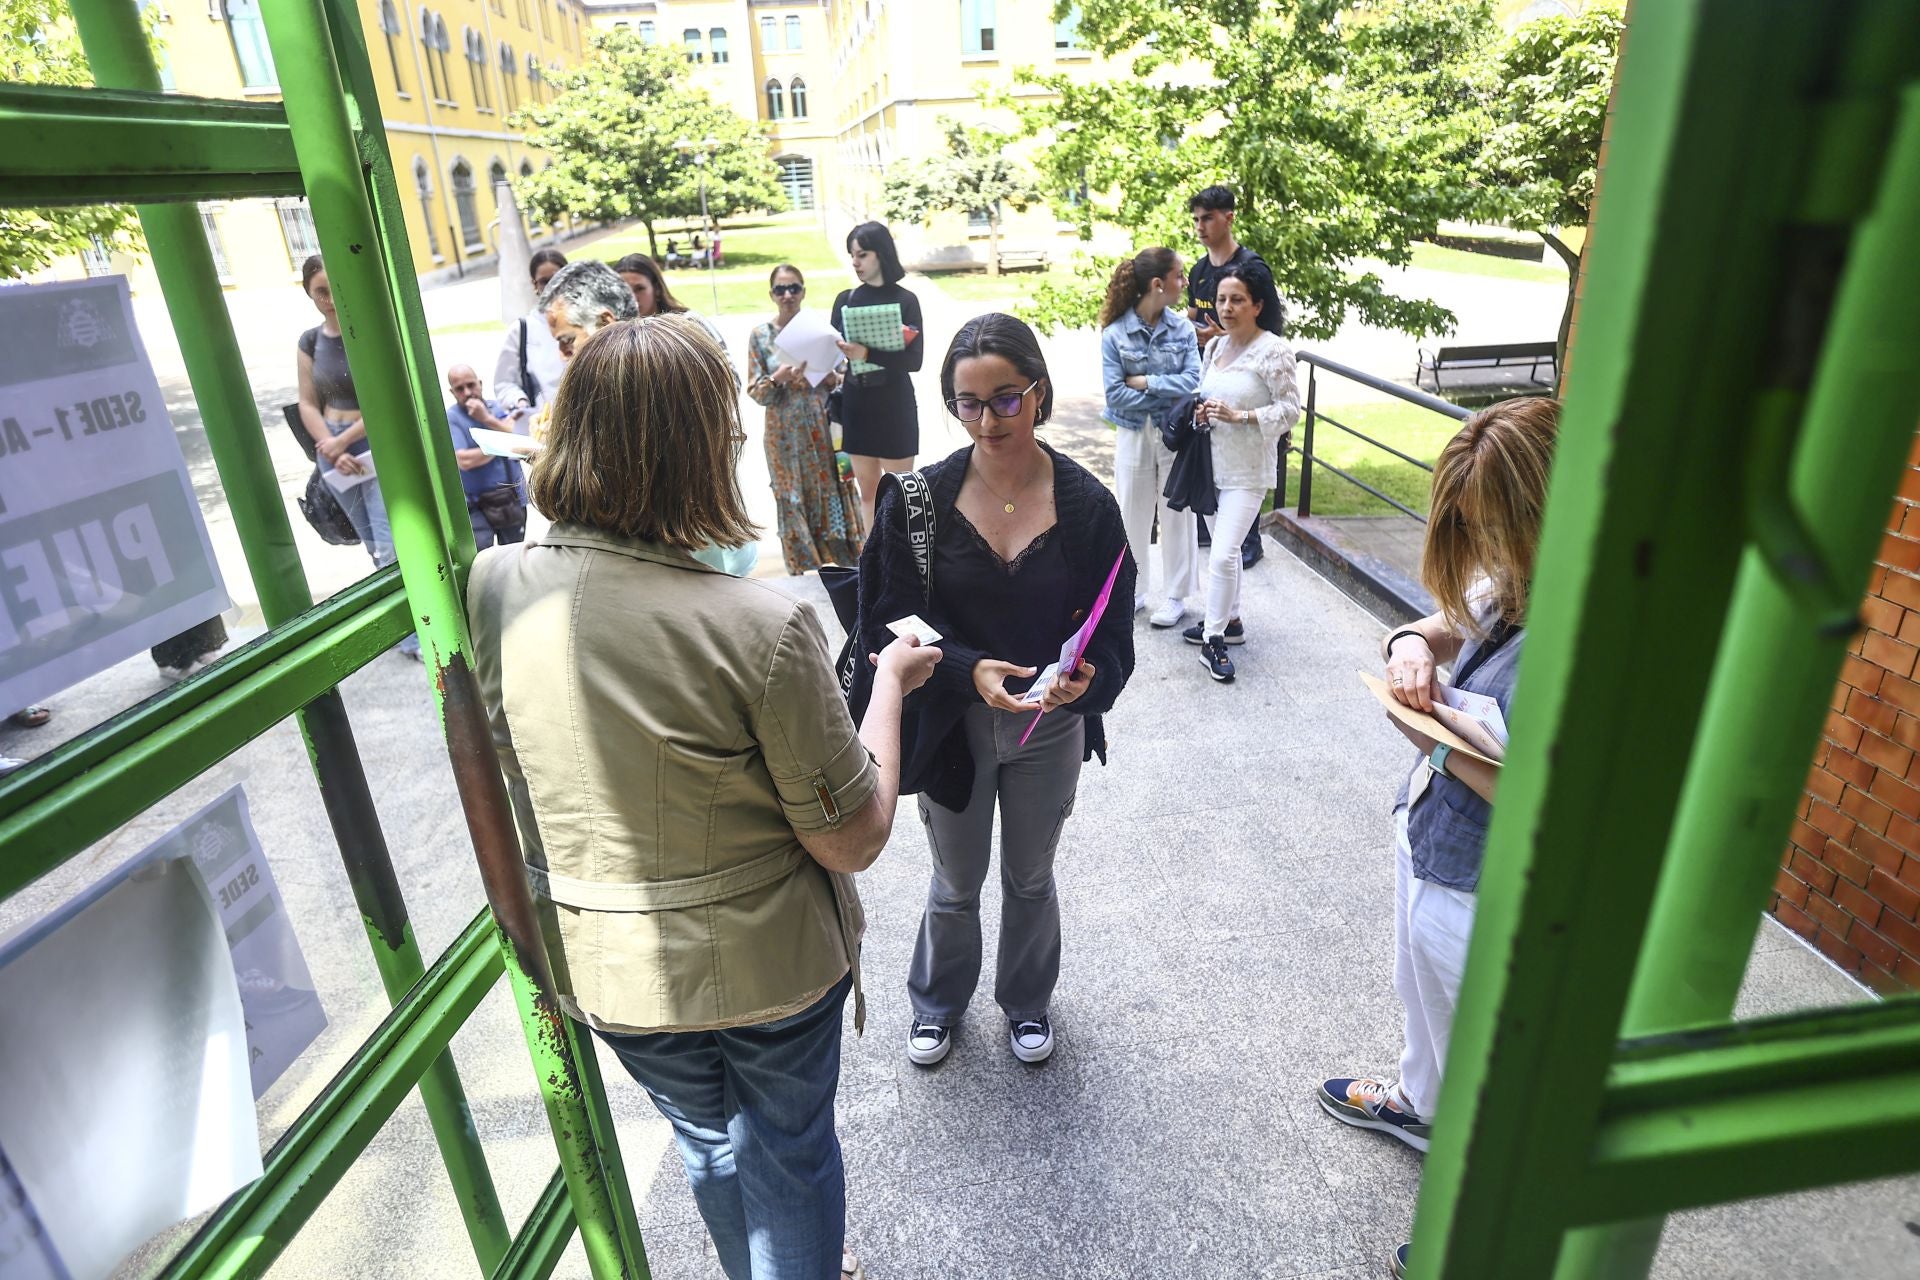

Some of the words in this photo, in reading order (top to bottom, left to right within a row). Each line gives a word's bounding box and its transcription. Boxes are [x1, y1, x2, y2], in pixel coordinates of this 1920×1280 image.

[898, 472, 923, 520] LOLA
[910, 530, 927, 585] BIM
[841, 657, 856, 698] LOLA
